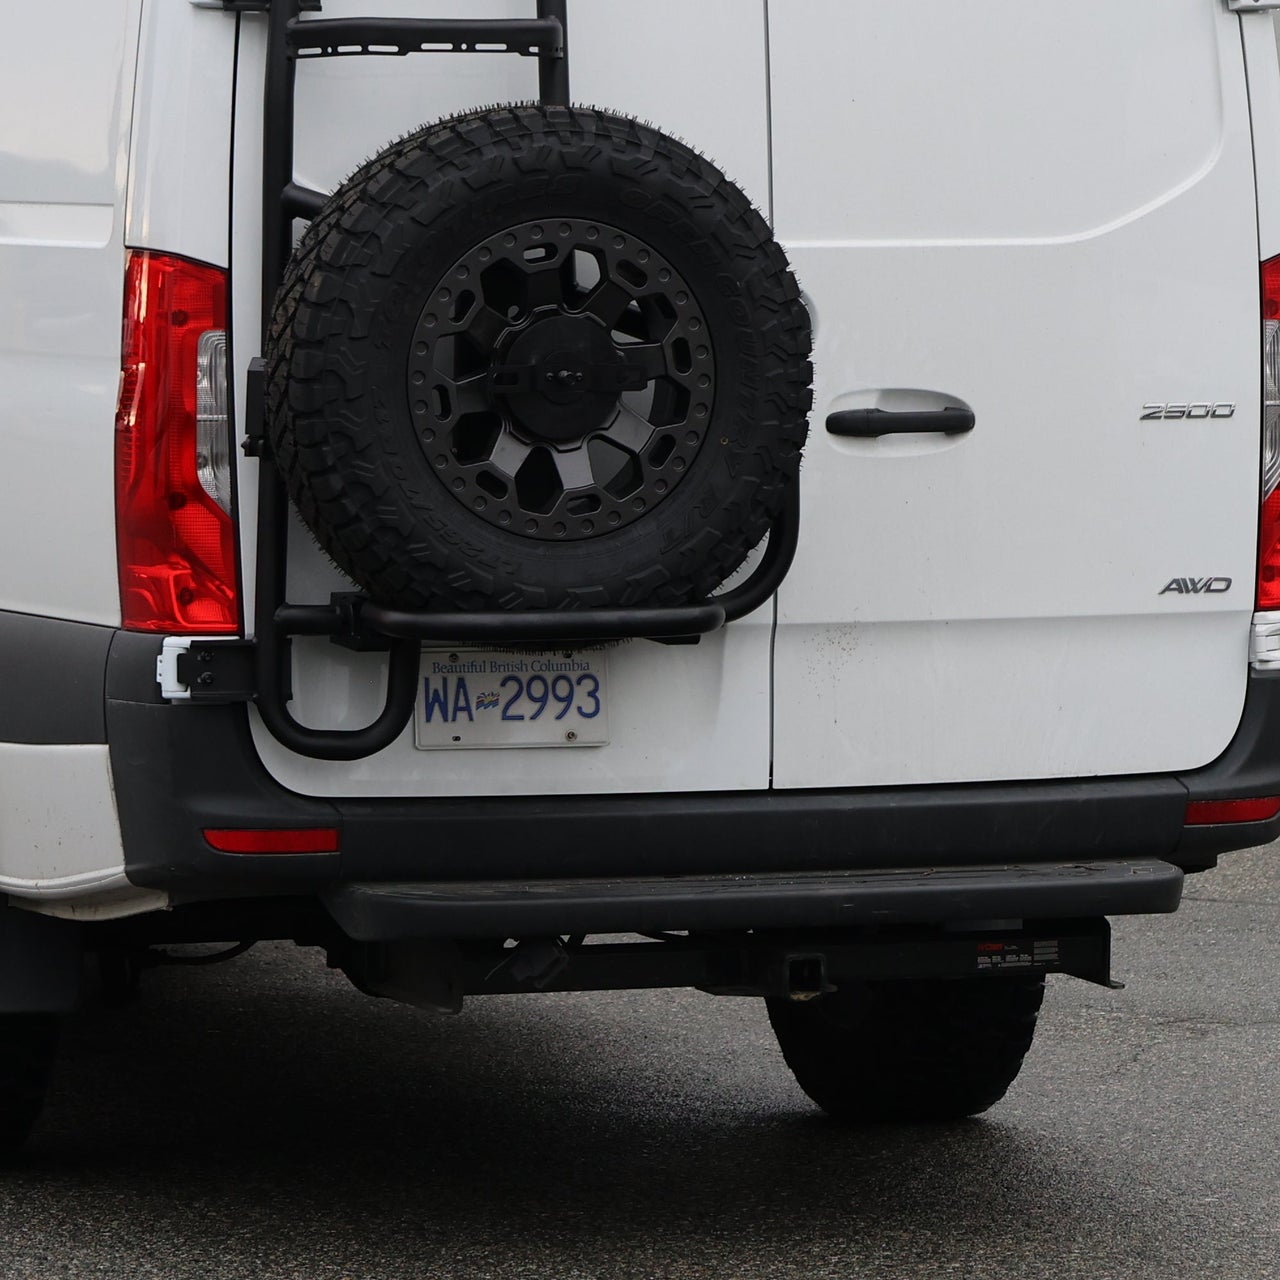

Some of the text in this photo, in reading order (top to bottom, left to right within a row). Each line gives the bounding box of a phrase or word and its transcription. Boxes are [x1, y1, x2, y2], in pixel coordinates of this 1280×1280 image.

[1139, 402, 1236, 420] 2500
[1158, 577, 1233, 595] AWD
[432, 659, 590, 674] Beautiful British Columbia
[423, 673, 601, 724] WA 2993
